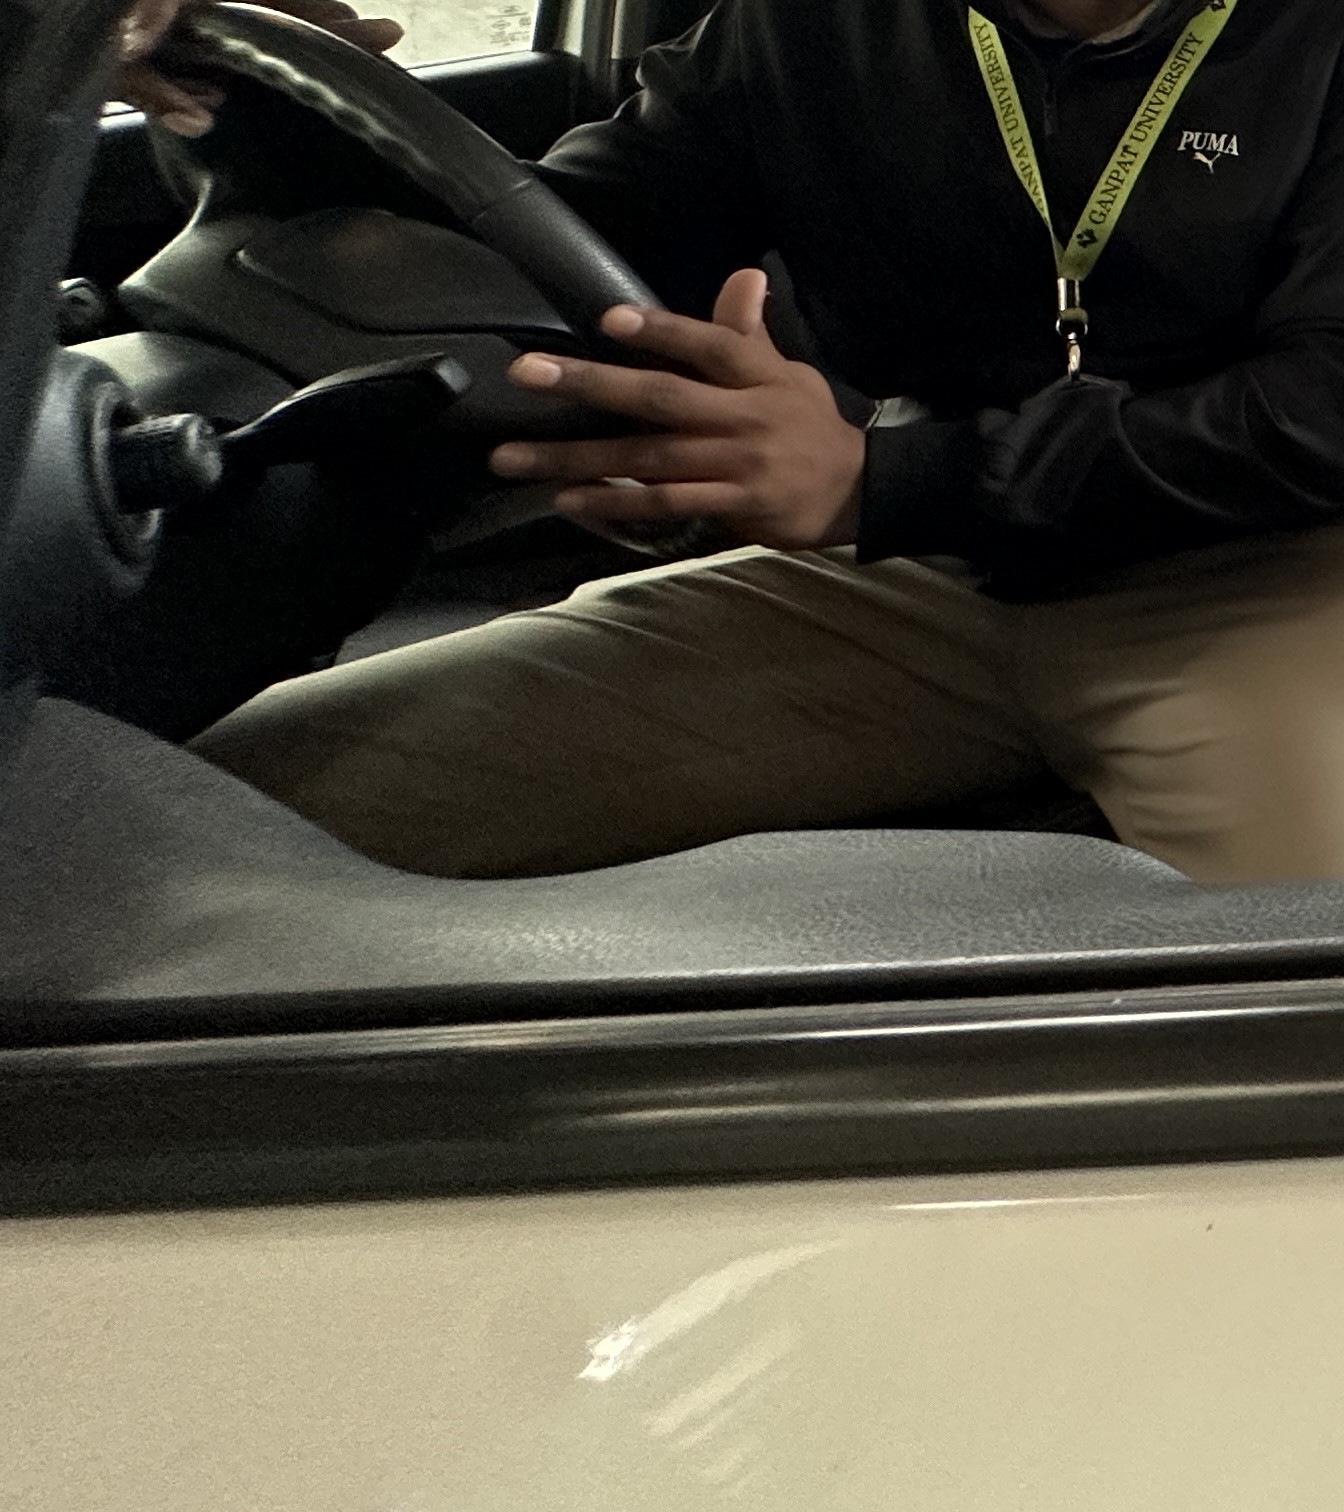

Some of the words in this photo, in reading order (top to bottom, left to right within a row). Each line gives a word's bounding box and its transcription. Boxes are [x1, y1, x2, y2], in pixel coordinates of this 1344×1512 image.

[974, 23, 1019, 133] UNIVERSITY
[1088, 144, 1139, 225] GANPAT
[1130, 31, 1204, 142] UNIVERSITY
[1177, 130, 1239, 156] PUMA
